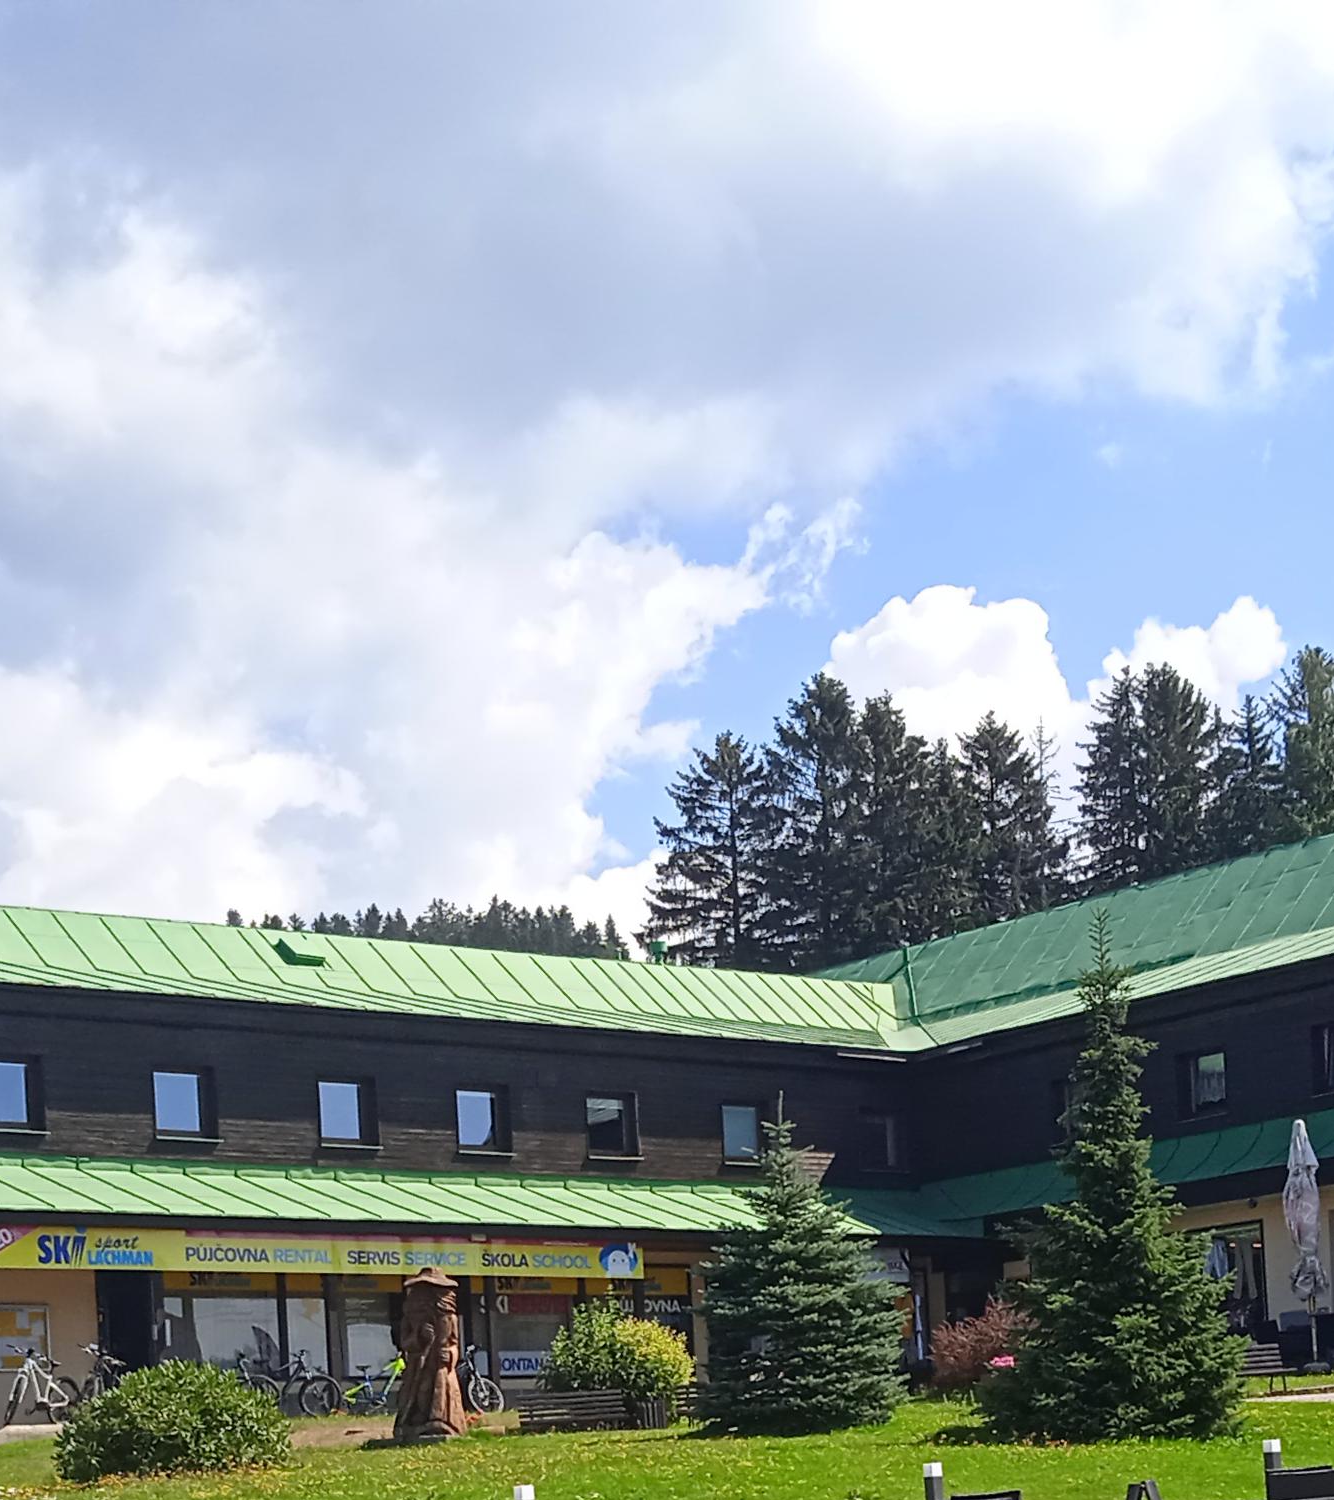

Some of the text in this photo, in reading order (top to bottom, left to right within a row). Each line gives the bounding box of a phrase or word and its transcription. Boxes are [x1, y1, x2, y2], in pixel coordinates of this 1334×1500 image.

[95, 1235, 139, 1252] sport
[88, 1249, 154, 1266] LACHMAN
[273, 1248, 332, 1264] RENTAL
[347, 1250, 400, 1266] SERVIS
[404, 1251, 466, 1267] SERVICE
[481, 1249, 529, 1268] ŠKOLA
[532, 1252, 592, 1269] SCHOOL
